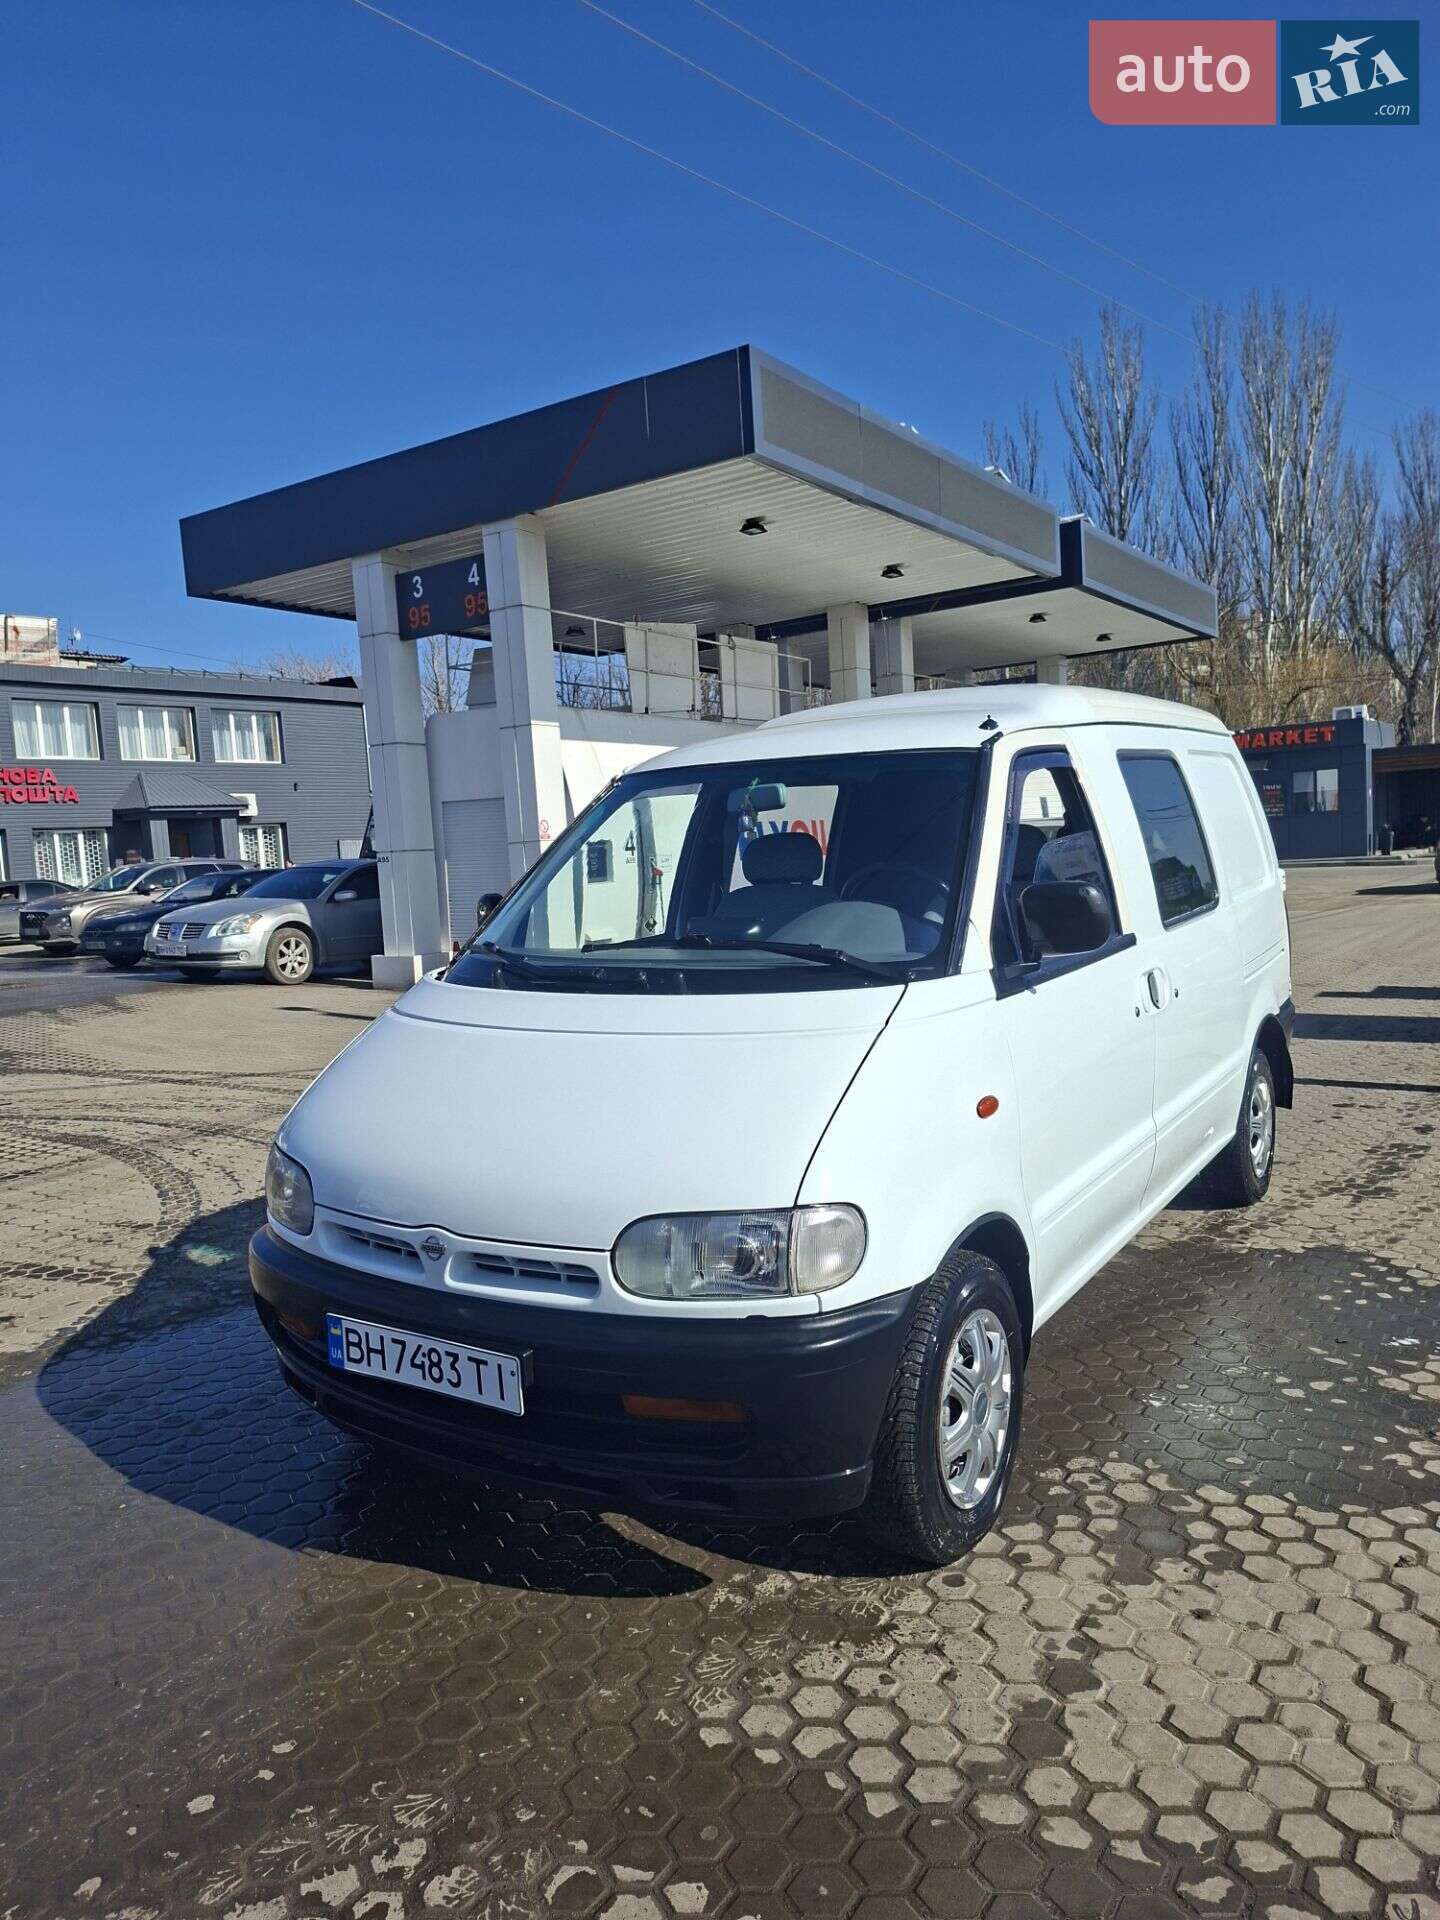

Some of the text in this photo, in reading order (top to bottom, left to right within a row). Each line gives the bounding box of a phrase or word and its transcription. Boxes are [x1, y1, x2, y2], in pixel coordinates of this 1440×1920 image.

[412, 563, 480, 598] 3 4
[409, 604, 431, 629] 95
[1232, 726, 1335, 749] MARKET
